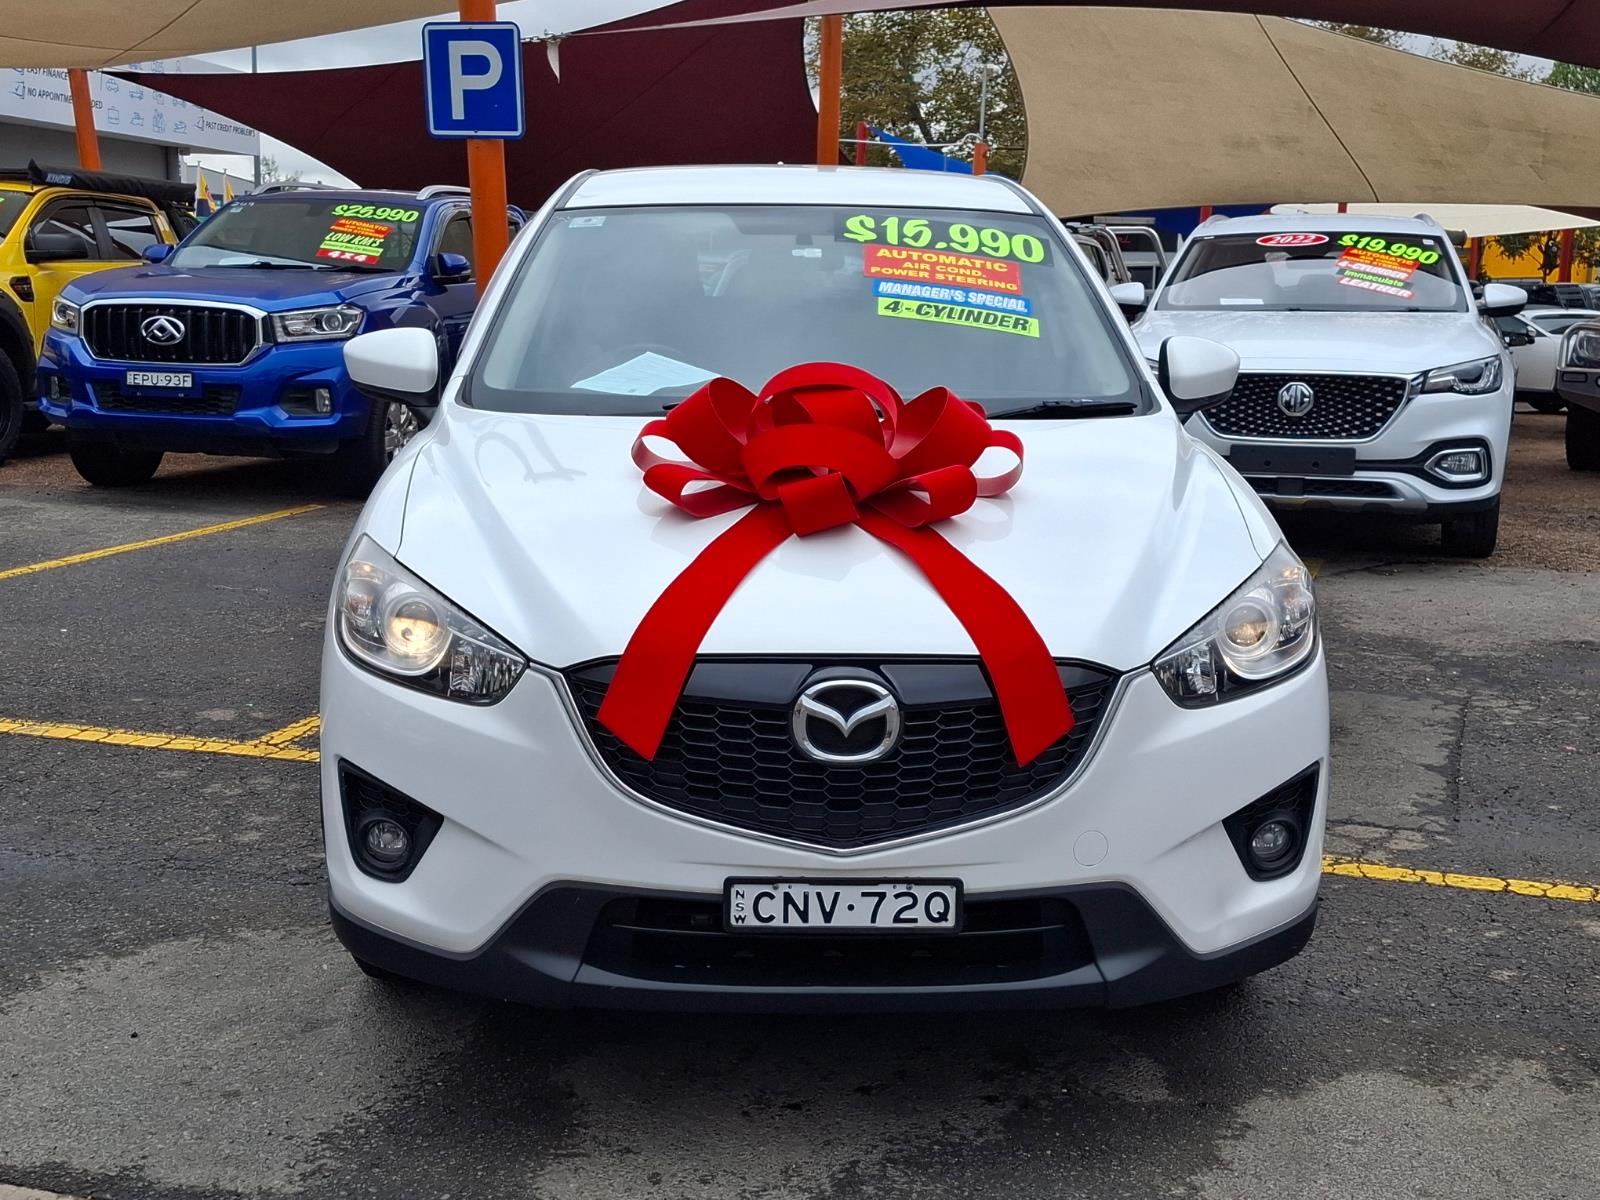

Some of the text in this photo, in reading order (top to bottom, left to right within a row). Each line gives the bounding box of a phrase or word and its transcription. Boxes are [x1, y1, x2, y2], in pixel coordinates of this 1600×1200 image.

[448, 40, 503, 120] P
[27, 87, 37, 97] NO
[325, 231, 355, 242] LOW
[1266, 234, 1312, 244] 2022
[876, 248, 1008, 272] AUTOMATIC
[1350, 248, 1415, 265] AUTOMATIC
[870, 266, 1019, 291] POWER STEERING
[902, 261, 986, 278] AIR COND.
[878, 282, 1028, 312] MANAGER'S SPECIAL
[1339, 277, 1414, 298] LEATHER
[1281, 384, 1311, 413] MG
